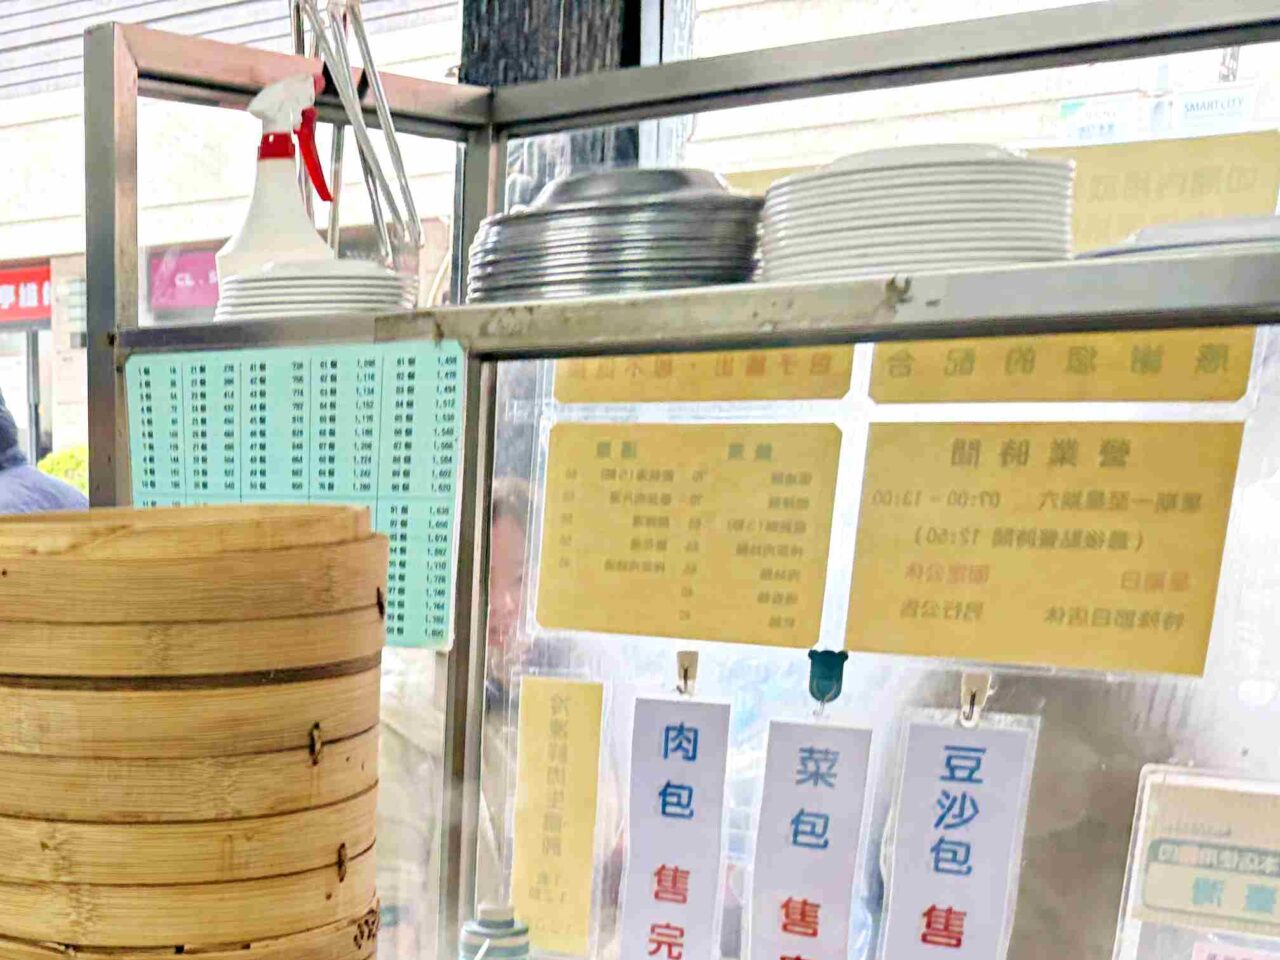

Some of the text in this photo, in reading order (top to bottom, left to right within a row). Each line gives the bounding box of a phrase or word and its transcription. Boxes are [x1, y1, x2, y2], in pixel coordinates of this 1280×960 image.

[658, 722, 700, 820] 肉包
[790, 746, 838, 850] 菜包
[931, 745, 988, 876] 豆沙包
